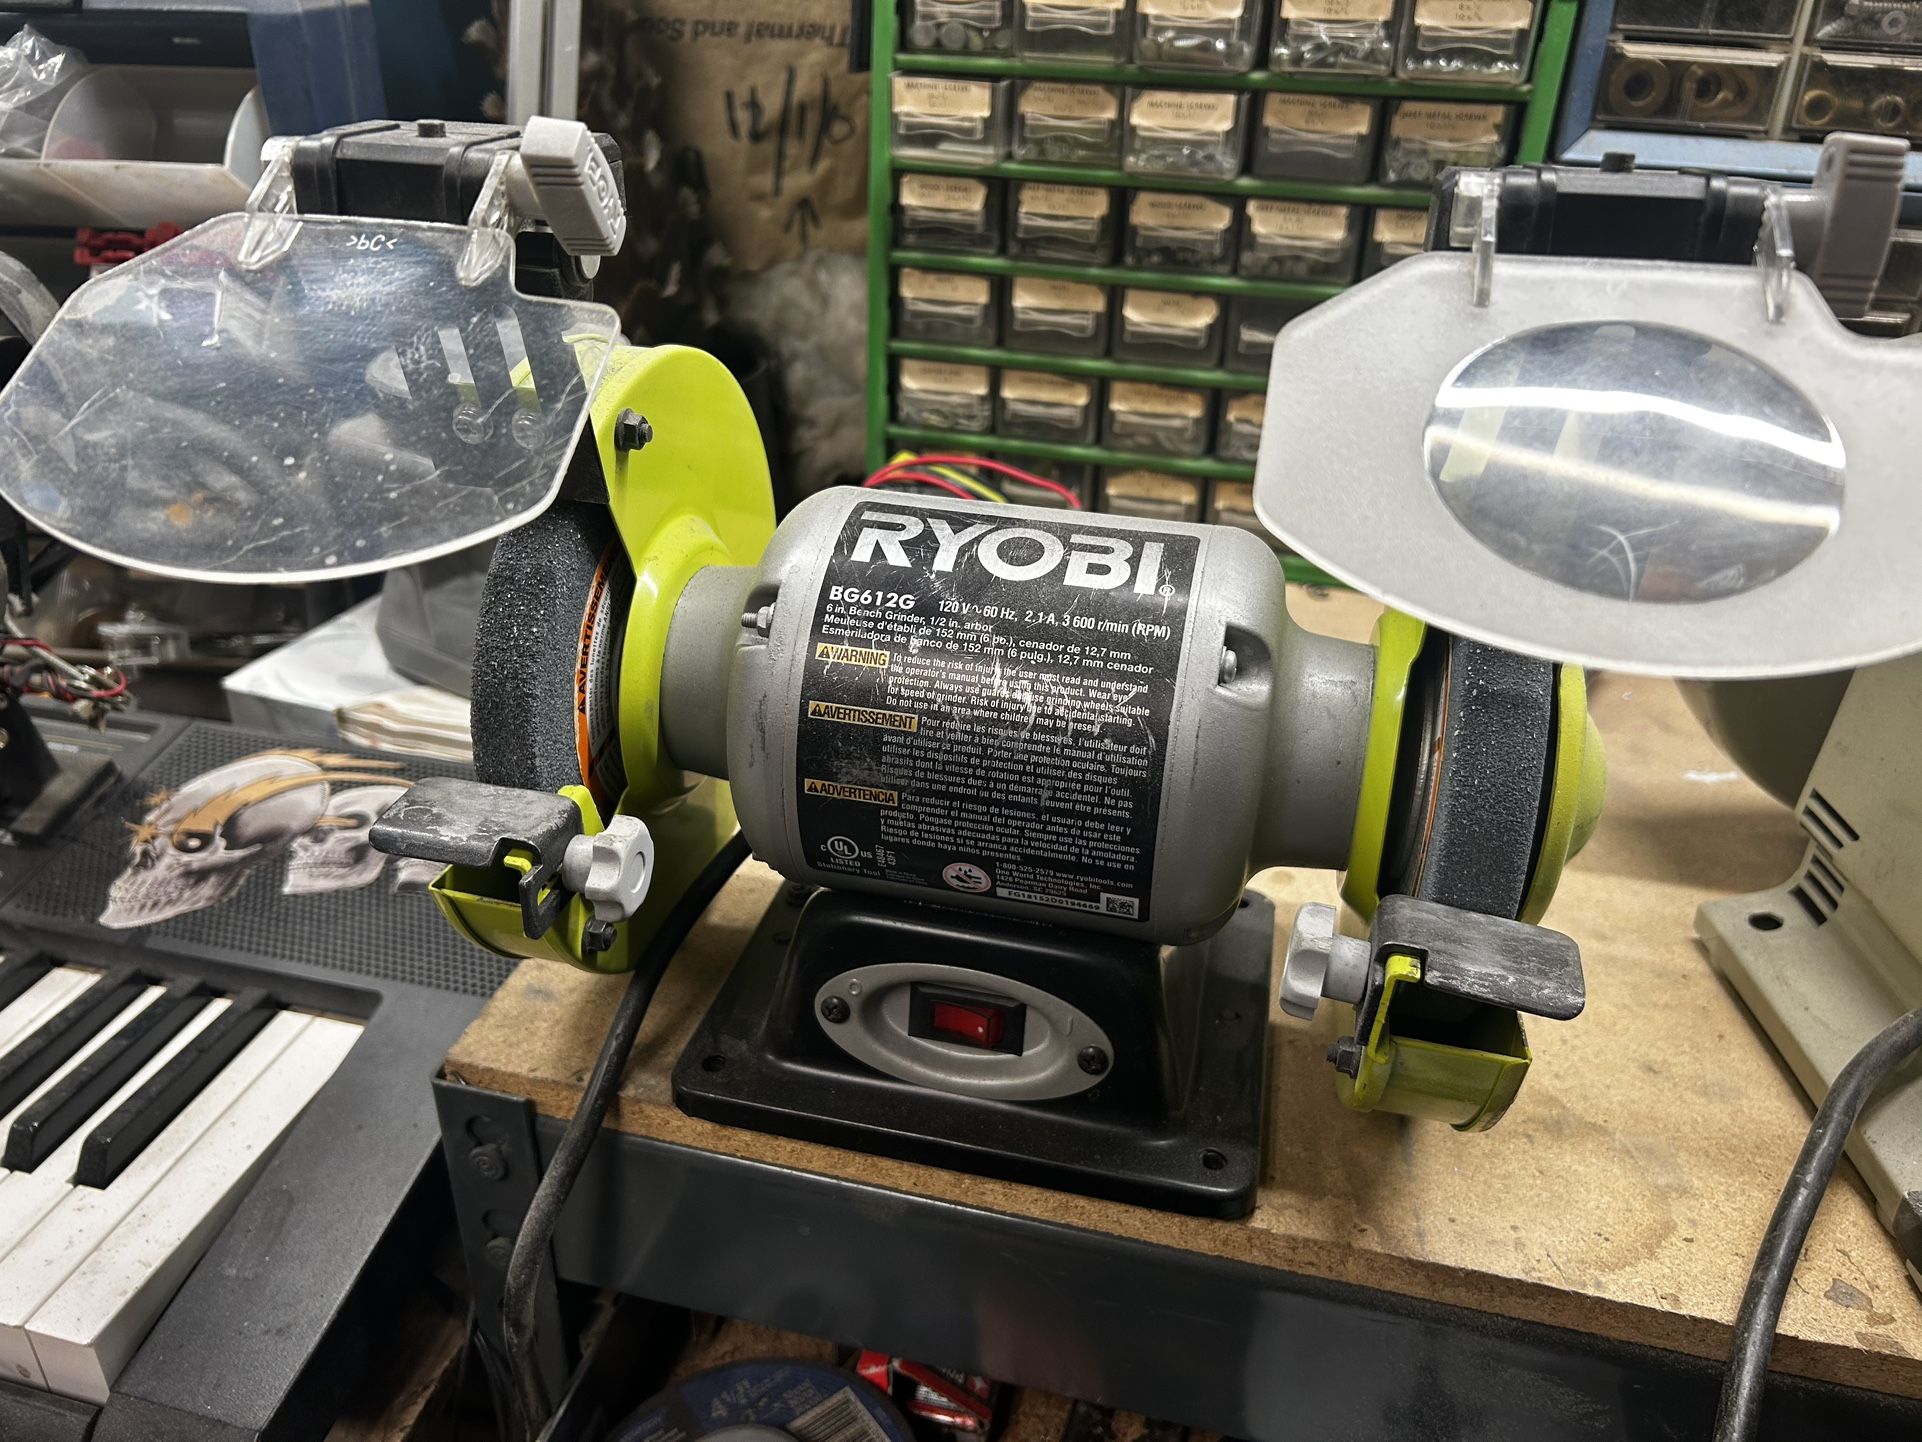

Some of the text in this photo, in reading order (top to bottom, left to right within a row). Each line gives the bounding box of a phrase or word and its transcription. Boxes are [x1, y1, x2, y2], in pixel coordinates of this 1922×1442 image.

[691, 18, 740, 42] and
[850, 510, 1164, 595] RYOBI
[828, 585, 916, 611] BG612G
[826, 603, 993, 631] 6 in. Bench Grinder, 1/2 in. arbor
[938, 599, 959, 613] 120
[982, 604, 997, 618] 60
[999, 607, 1018, 622] Hz,
[1072, 615, 1095, 629] 600
[1097, 618, 1128, 636] r/min
[1131, 622, 1170, 641] (RPM)
[821, 624, 890, 641] Esmeriladora
[893, 633, 907, 643] de
[945, 640, 959, 650] de
[962, 642, 980, 652] 152
[983, 646, 1002, 655] mm
[1007, 647, 1017, 659] (6
[1019, 649, 1053, 663] pulg.),
[1057, 654, 1079, 666] 12,7
[1082, 658, 1103, 668] mm
[1106, 660, 1153, 674] cenador
[824, 614, 873, 628] Meuleuse
[877, 620, 915, 633] d'établi
[918, 625, 932, 635] de
[935, 627, 953, 638] 152
[956, 632, 976, 641] mm
[980, 633, 989, 644] (6
[1019, 638, 1064, 651] cenador
[1066, 643, 1080, 653] de
[1084, 645, 1106, 658] 12,7
[1109, 650, 1131, 659] mm
[830, 646, 887, 666] WARNING
[893, 653, 902, 662] To
[903, 654, 930, 666] reduce
[932, 658, 945, 668] the
[947, 660, 962, 670] risk
[965, 662, 973, 671] of
[1018, 670, 1036, 679] user
[1061, 674, 1080, 684] read
[1082, 677, 1098, 687] and
[1100, 679, 1149, 693] understand
[905, 665, 946, 680] operator's
[948, 670, 978, 682] manual
[1088, 688, 1111, 699] Wear
[1112, 693, 1128, 703] eye
[887, 684, 898, 694] for
[900, 686, 924, 699] speed
[970, 695, 987, 706] Risk
[990, 698, 999, 707] of
[1100, 713, 1135, 727] starting.
[889, 674, 931, 690] protection.
[934, 680, 962, 694] Always
[965, 686, 979, 694] use
[1046, 695, 1081, 709] grinding
[823, 705, 914, 730] AVERTISSEMENT
[886, 696, 896, 705] Do
[899, 697, 912, 707] not
[914, 701, 928, 709] use
[953, 706, 970, 715] area
[973, 707, 997, 718] where
[1035, 717, 1053, 728] may
[882, 733, 904, 743] avant
[905, 736, 939, 748] d'utiliser
[1030, 754, 1070, 769] protection
[1072, 760, 1107, 772] oculaire.
[1110, 765, 1147, 779] Toujours
[821, 783, 894, 804] ADVERTENCIA
[901, 802, 1121, 841] comprender el manual del operador antes de usar este
[830, 856, 860, 866] LISTED
[834, 840, 851, 855] UL
[816, 861, 859, 873] Stationary
[1012, 871, 1034, 879] World
[1036, 874, 1084, 887] Technologies,
